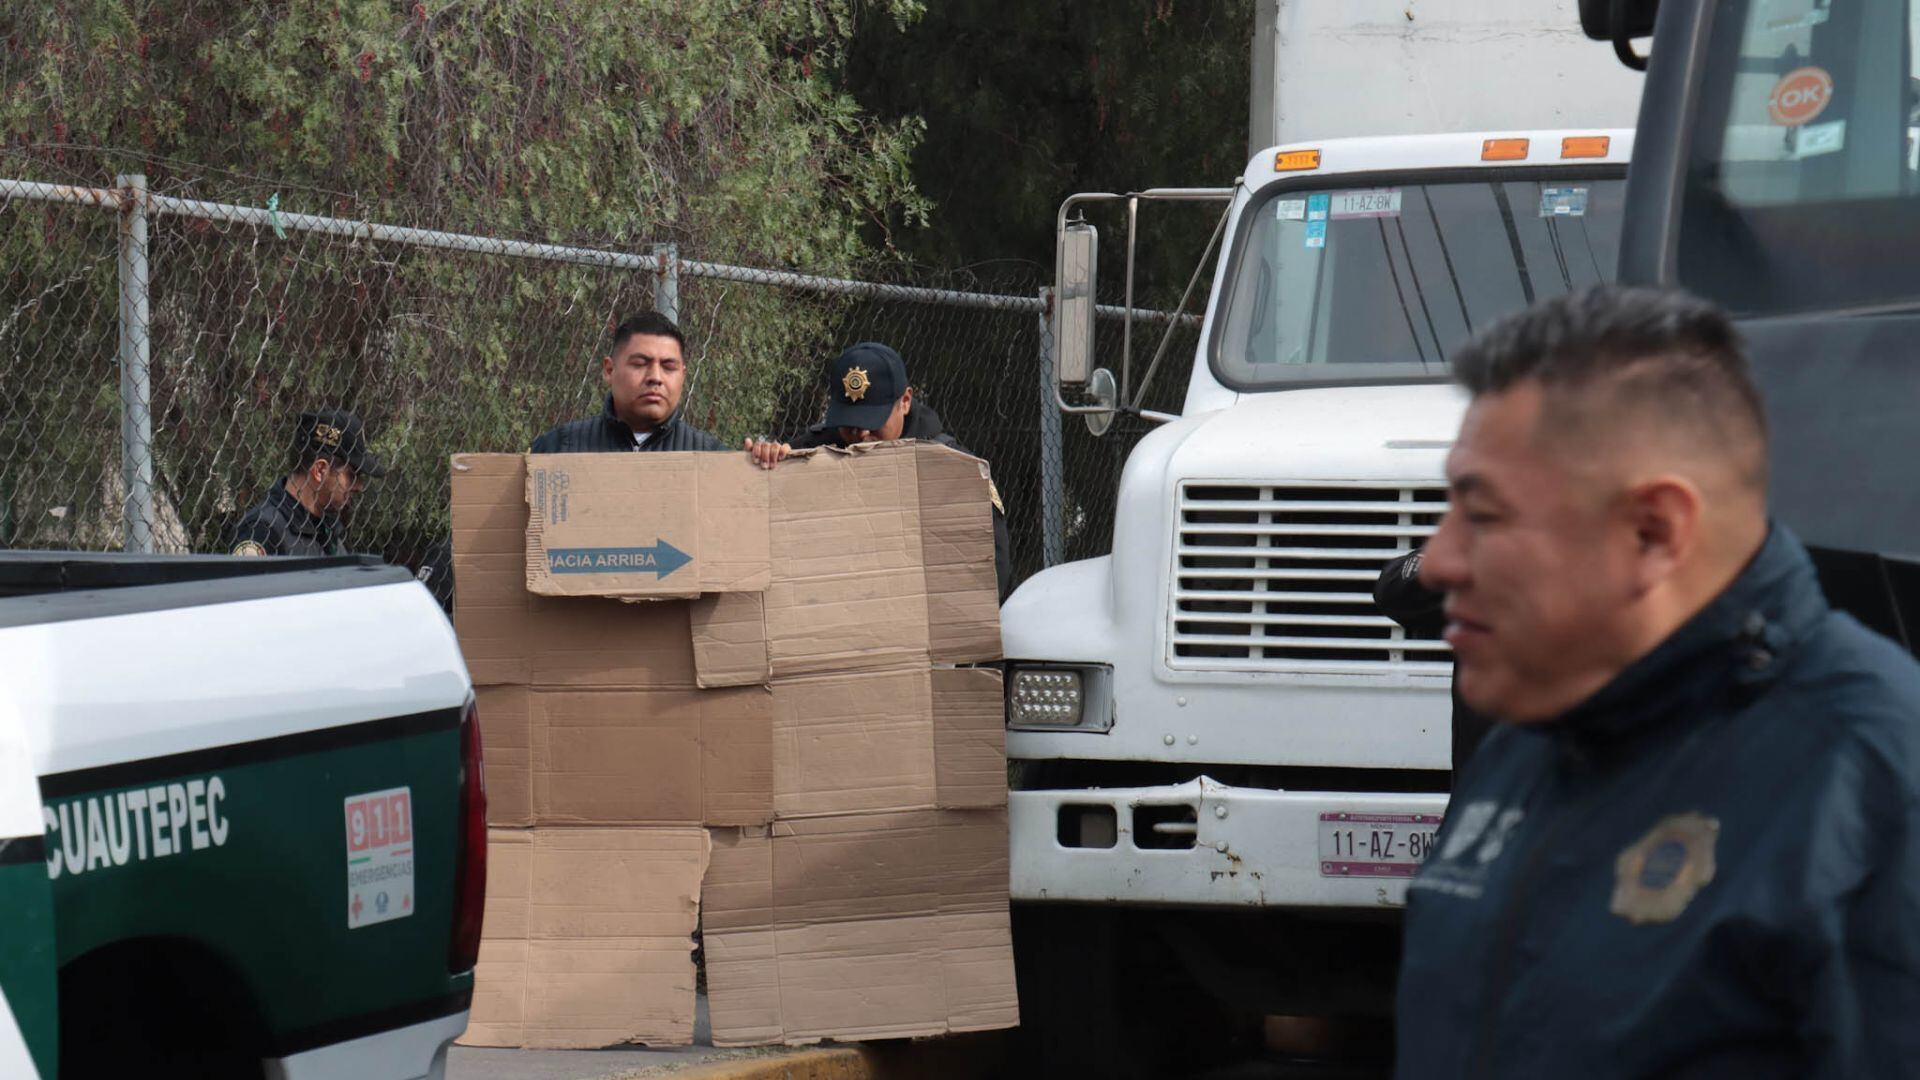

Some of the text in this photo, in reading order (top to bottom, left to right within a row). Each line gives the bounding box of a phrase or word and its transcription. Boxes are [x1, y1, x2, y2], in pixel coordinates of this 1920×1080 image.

[1781, 85, 1821, 108] OK
[595, 553, 657, 567] ARRIBA
[43, 775, 229, 880] CUAUTEPEC
[351, 800, 405, 847] 911
